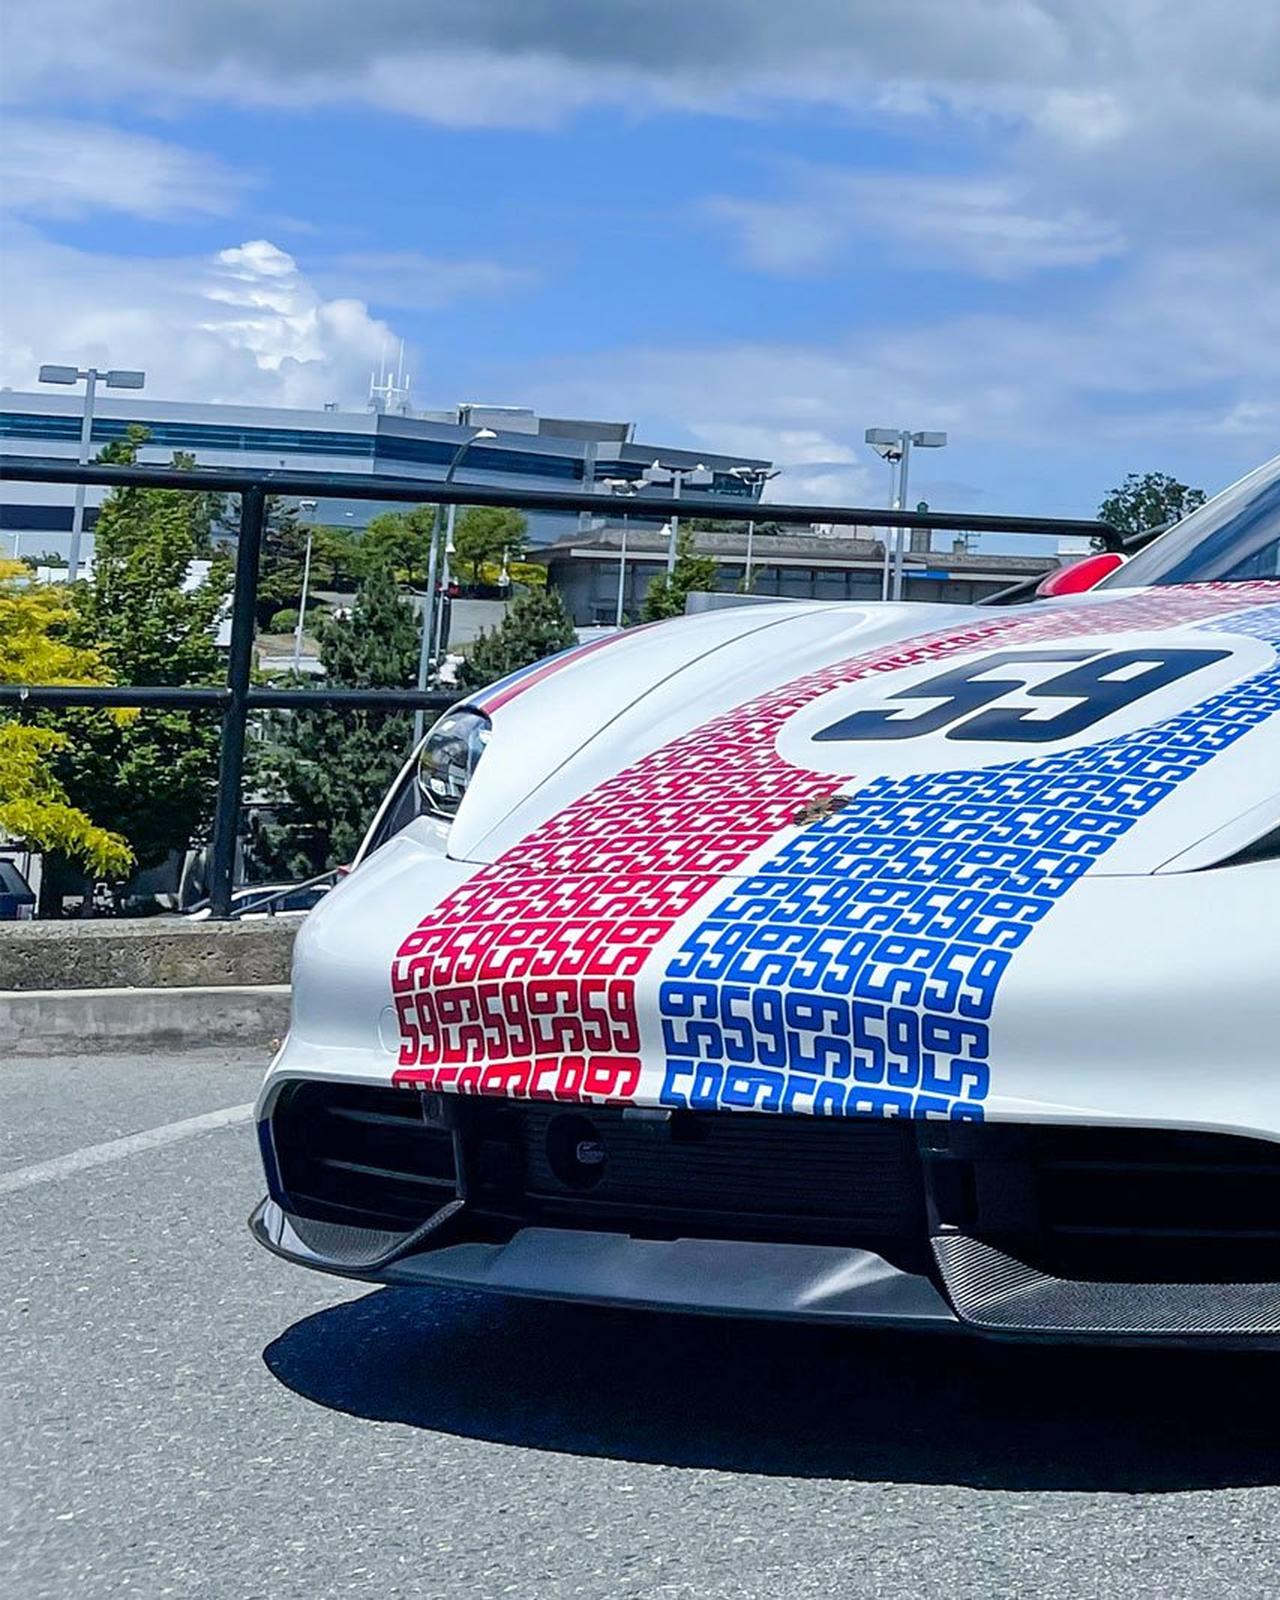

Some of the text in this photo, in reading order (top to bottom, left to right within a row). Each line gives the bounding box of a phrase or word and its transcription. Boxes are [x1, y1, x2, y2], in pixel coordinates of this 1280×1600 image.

[811, 648, 1234, 742] 59
[1127, 748, 1216, 781] 59
[1166, 720, 1254, 750] 59
[620, 801, 711, 833] 59
[674, 800, 765, 832] 59
[907, 770, 1006, 800] 59
[966, 773, 1058, 804] 59
[1023, 774, 1117, 805] 59
[1087, 780, 1177, 816] 59
[626, 835, 718, 872] 59
[680, 834, 773, 871] 59
[863, 801, 957, 838] 59
[920, 804, 1016, 840] 59
[980, 807, 1067, 849] 59
[1041, 812, 1138, 856] 59
[759, 835, 1096, 898] 59 59 59 59 59
[418, 875, 723, 928] 59 59 59 59 59
[708, 876, 1055, 949] 59 59 59 59 59
[391, 920, 675, 993] 59 59 59 59 59
[666, 922, 1014, 1021] 59 59 59 59 59
[394, 979, 641, 1066] 59 59 59 59 59
[659, 981, 723, 1060] 59
[721, 985, 787, 1068] 59
[785, 992, 851, 1080] 59
[852, 999, 921, 1089] 59
[920, 1013, 990, 1101] 59
